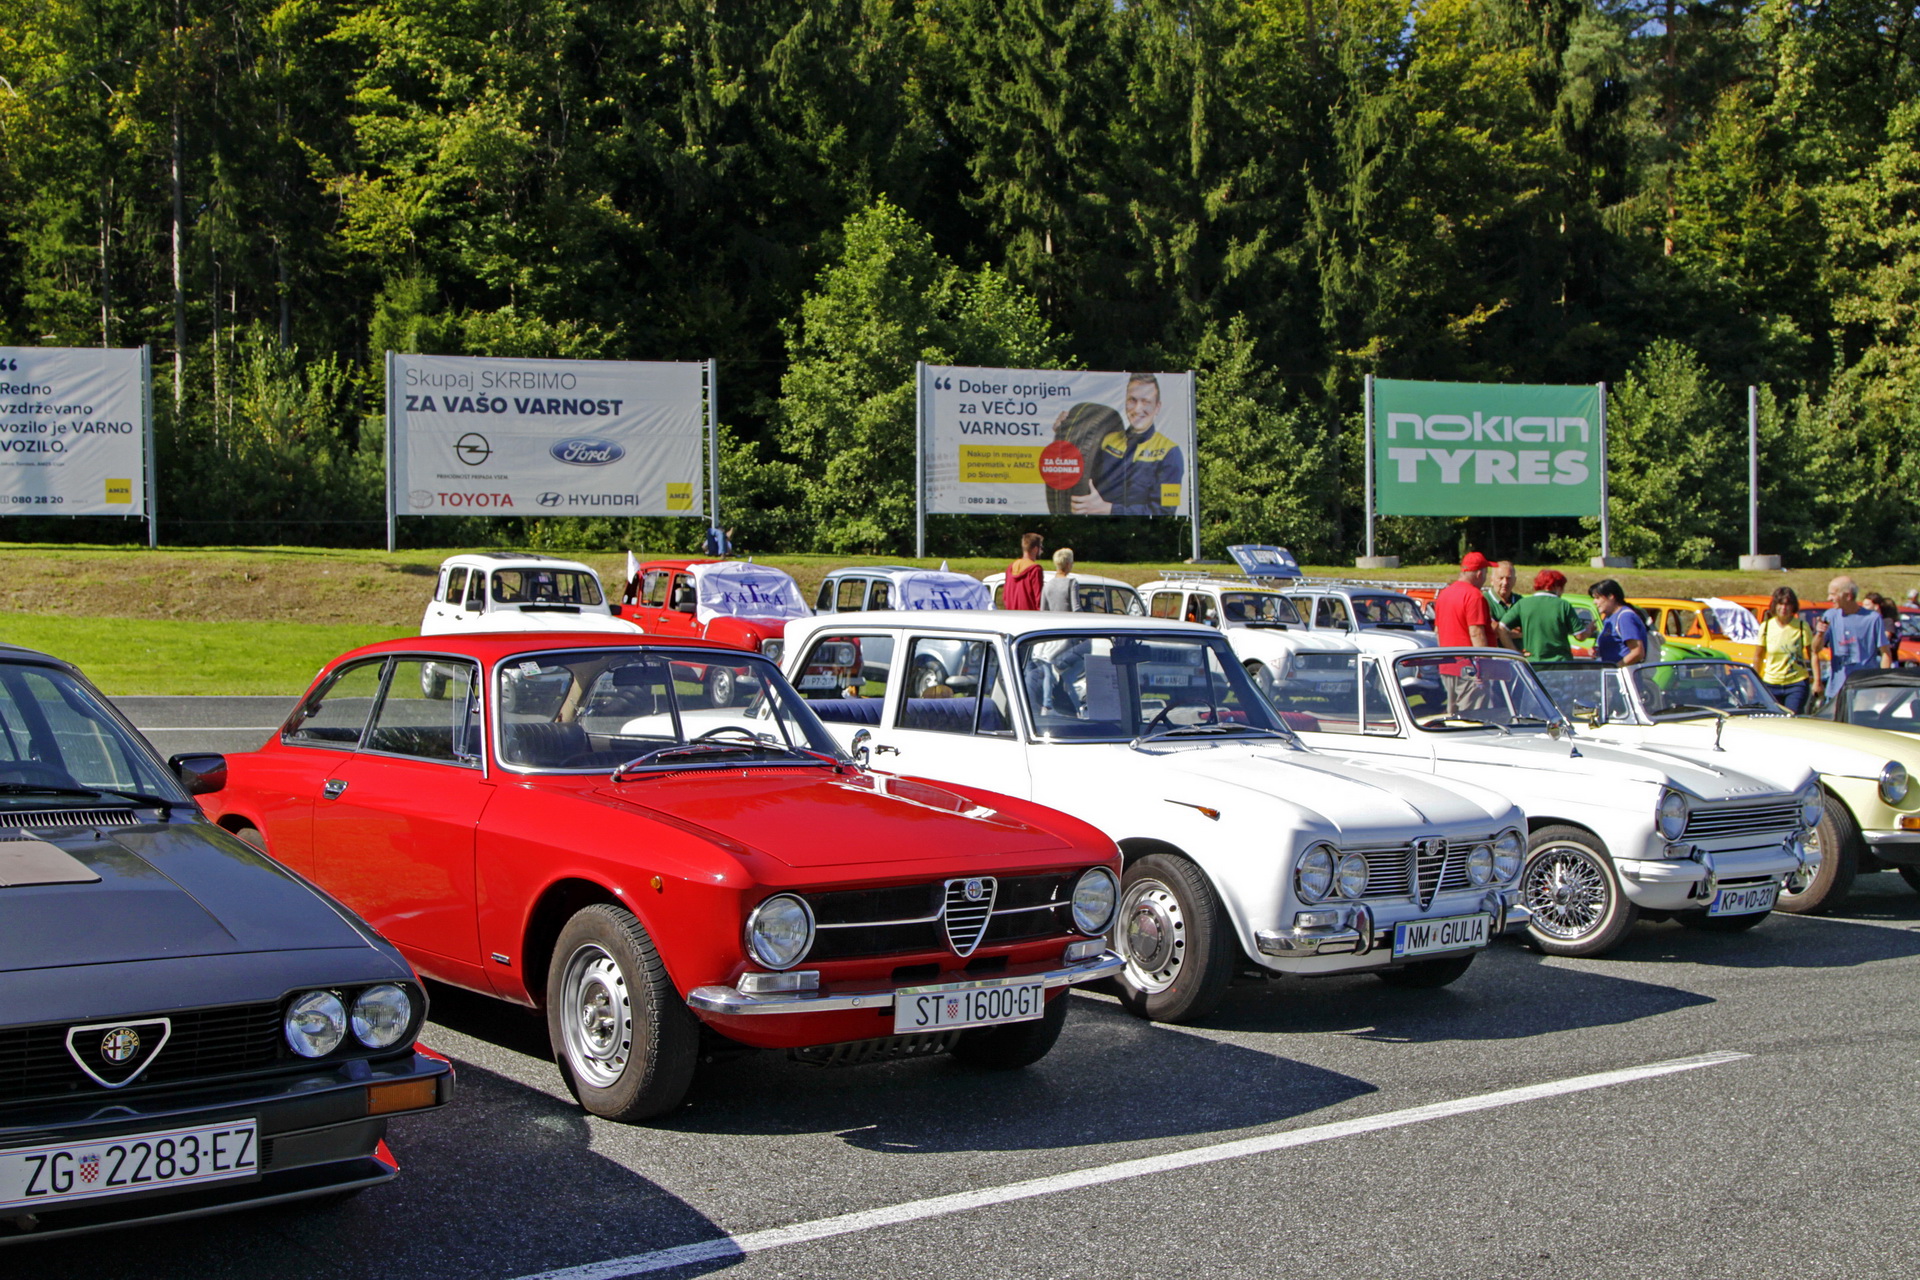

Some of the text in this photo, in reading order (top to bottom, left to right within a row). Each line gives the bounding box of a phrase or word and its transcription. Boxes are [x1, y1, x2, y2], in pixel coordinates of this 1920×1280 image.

[405, 368, 577, 392] Skupaj SKRBIMO
[0, 382, 52, 395] Redno
[959, 379, 1071, 399] Dober oprijem
[0, 402, 93, 415] vzdrževano
[405, 392, 623, 416] ZA VAŠO VARNOST
[959, 398, 1038, 415] za VEČJO
[0, 421, 133, 437] vozilo je VARNO
[959, 421, 1043, 436] VARNOST.
[0, 440, 68, 453] VOZILO.
[564, 440, 611, 461] Ford
[967, 451, 991, 459] Nakup
[1002, 452, 1032, 460] menjava
[967, 461, 1005, 469] pnevmatik
[1387, 447, 1589, 486] TYRES
[11, 496, 32, 504] 080
[34, 496, 48, 504] 28
[50, 495, 64, 504] 20
[438, 492, 514, 507] TOYOTA
[569, 494, 639, 506] HYUNDAI
[998, 497, 1008, 505] 20
[724, 583, 784, 606] KATRA
[1721, 892, 1738, 911] KP
[1407, 918, 1483, 949] NM GIULIA
[915, 995, 945, 1026] ST
[24, 1152, 74, 1197] ZG
